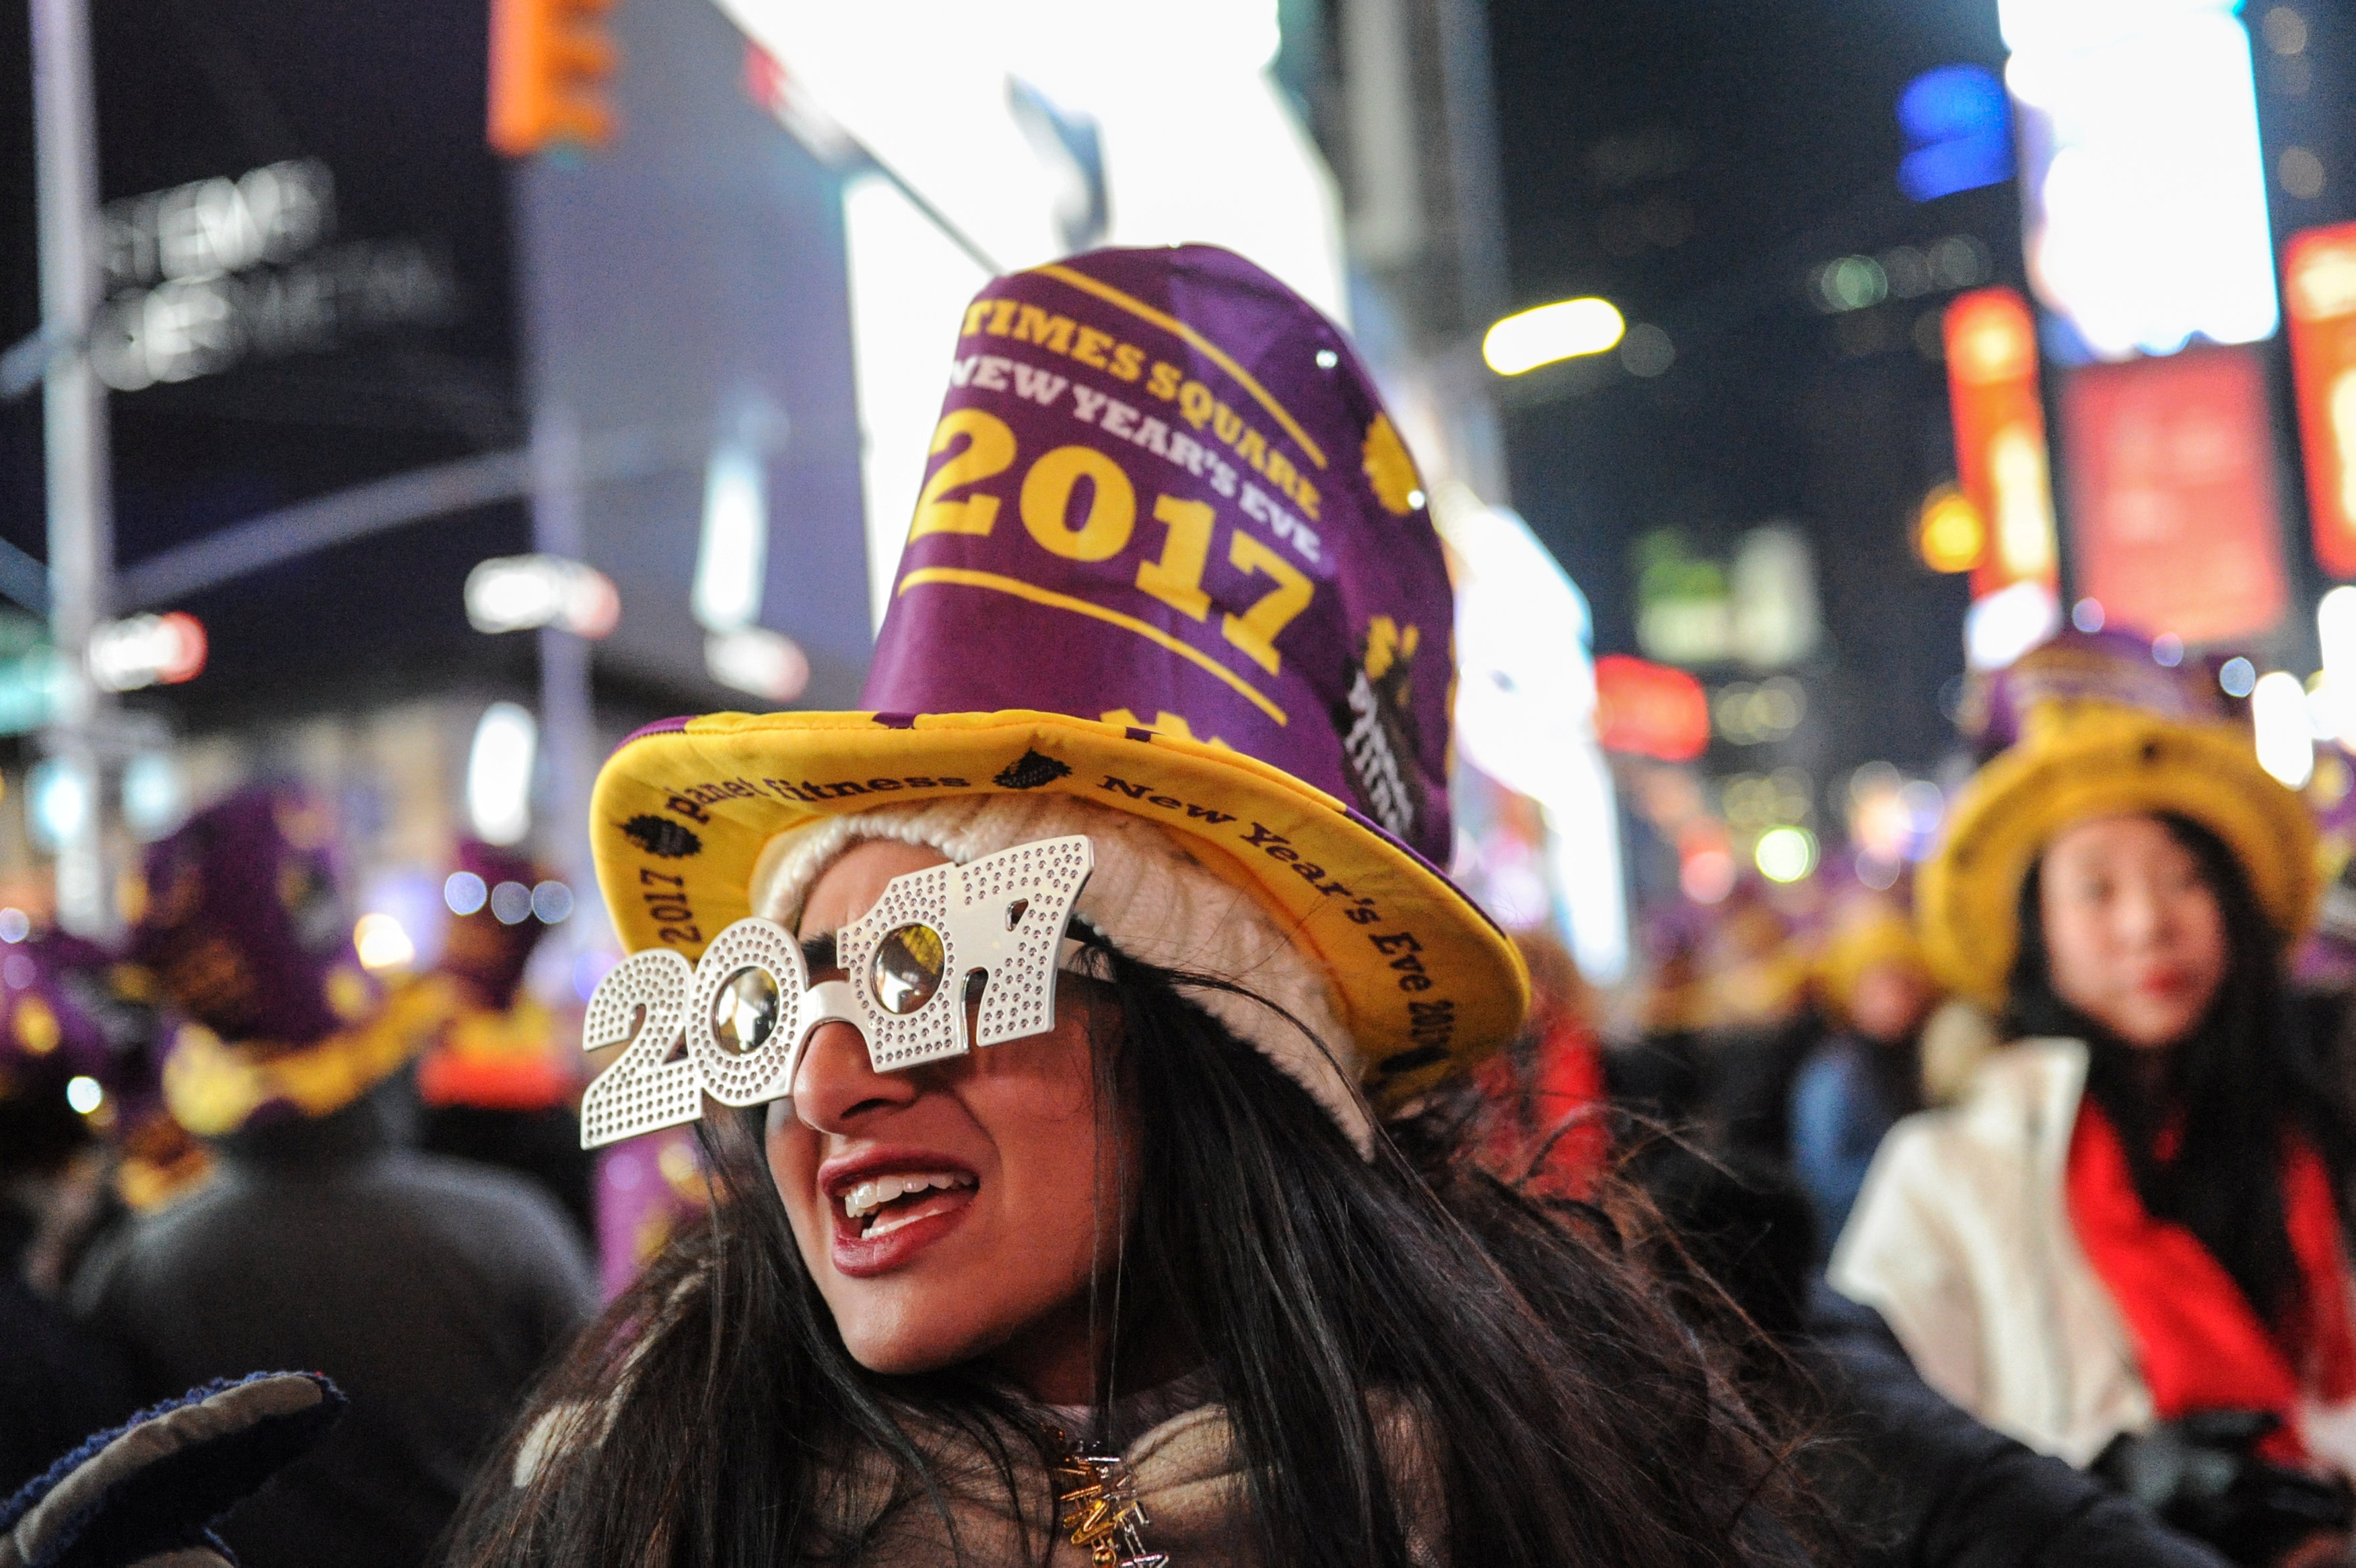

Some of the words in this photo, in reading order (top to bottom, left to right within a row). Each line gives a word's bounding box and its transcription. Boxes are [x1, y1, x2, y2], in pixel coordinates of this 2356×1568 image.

[960, 299, 1144, 382] TIMES
[1146, 361, 1323, 522] SQUARE
[1072, 382, 1237, 497] YEAR'S
[1238, 480, 1321, 564] EVE
[907, 408, 1315, 676] 2017
[640, 868, 703, 943] 2017
[663, 777, 771, 825] planet
[762, 777, 971, 802] fitness
[1096, 775, 1237, 824] New
[1239, 822, 1381, 925] Year's
[1368, 931, 1432, 992] Eve
[580, 834, 1095, 1149] 2017
